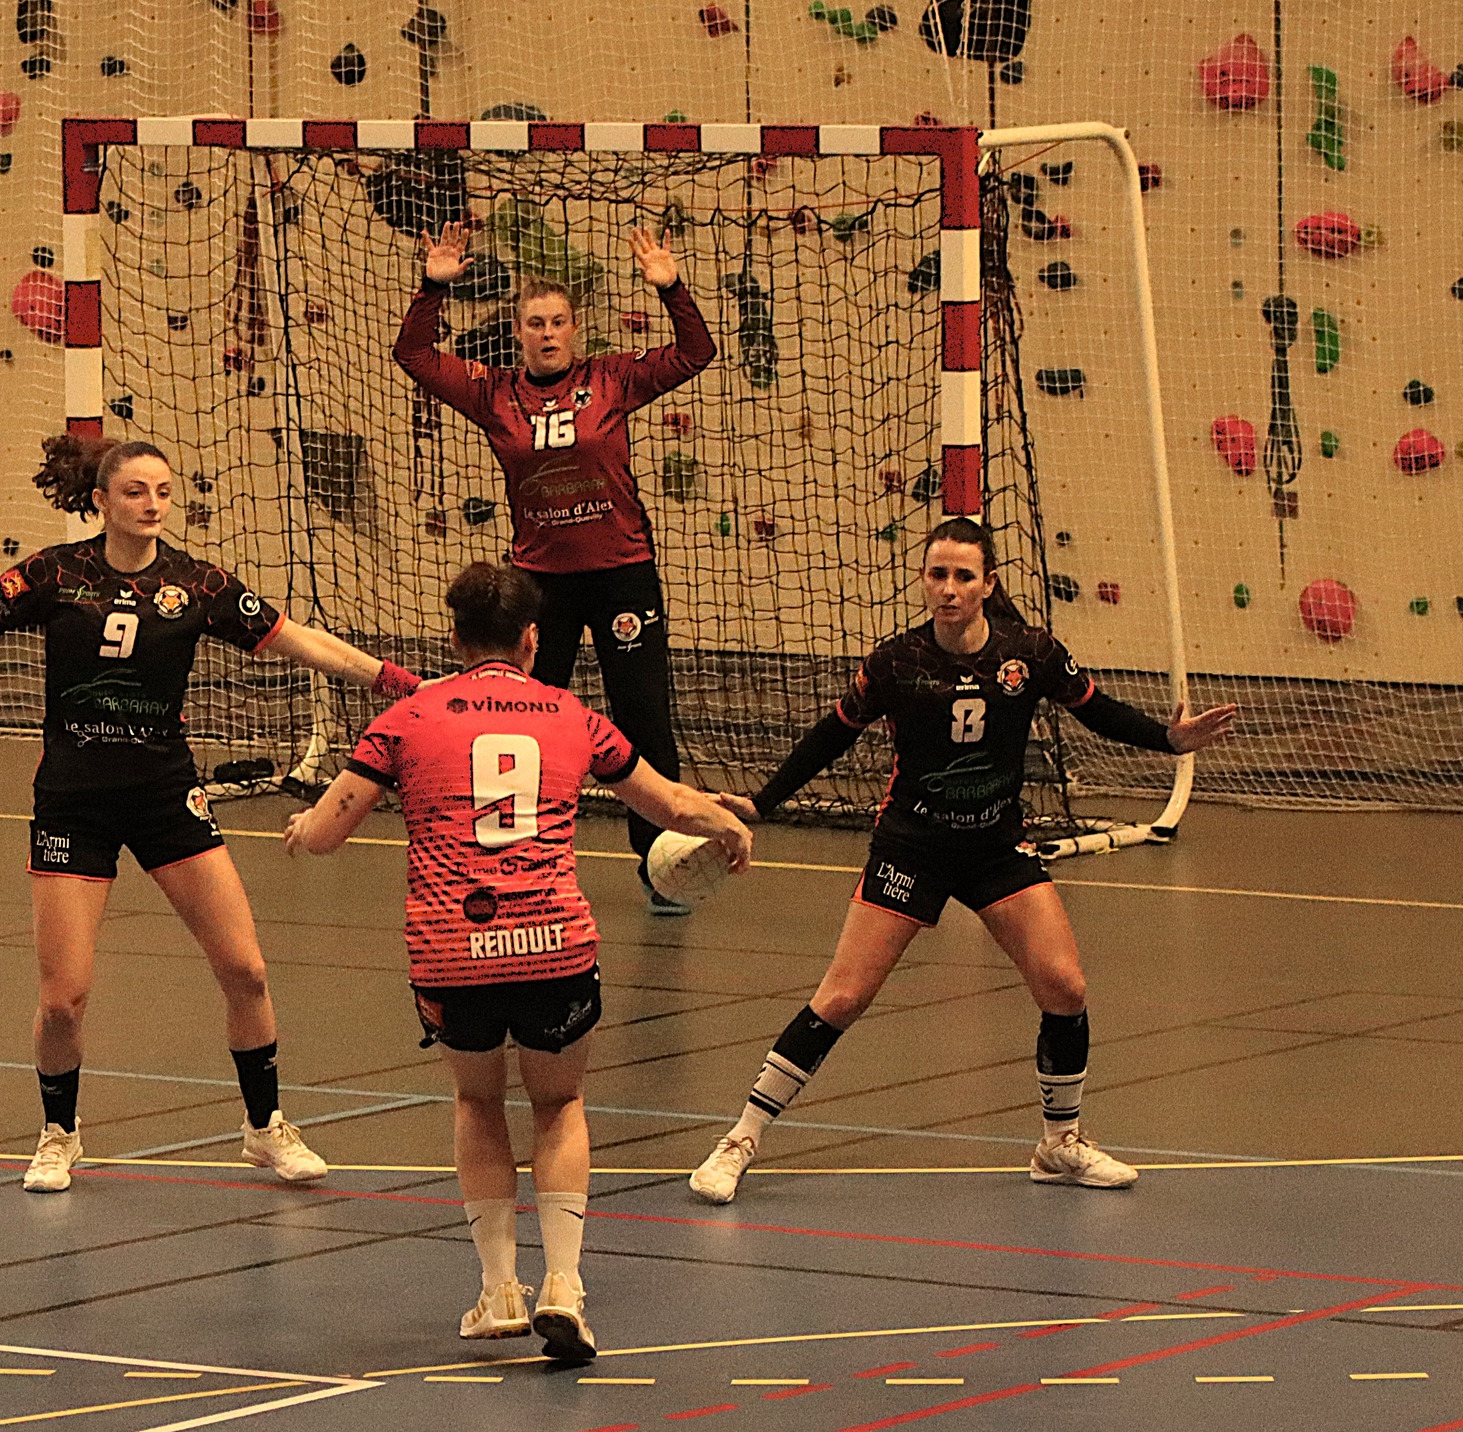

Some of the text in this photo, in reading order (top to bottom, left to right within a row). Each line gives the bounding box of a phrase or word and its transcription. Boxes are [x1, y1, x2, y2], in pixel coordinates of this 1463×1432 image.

[530, 410, 576, 451] 16
[98, 611, 140, 659] 9
[84, 721, 124, 735] salon
[951, 698, 986, 743] 8
[472, 733, 542, 848] 9
[876, 861, 917, 890] L'Armi
[469, 923, 564, 960] RENOULT
